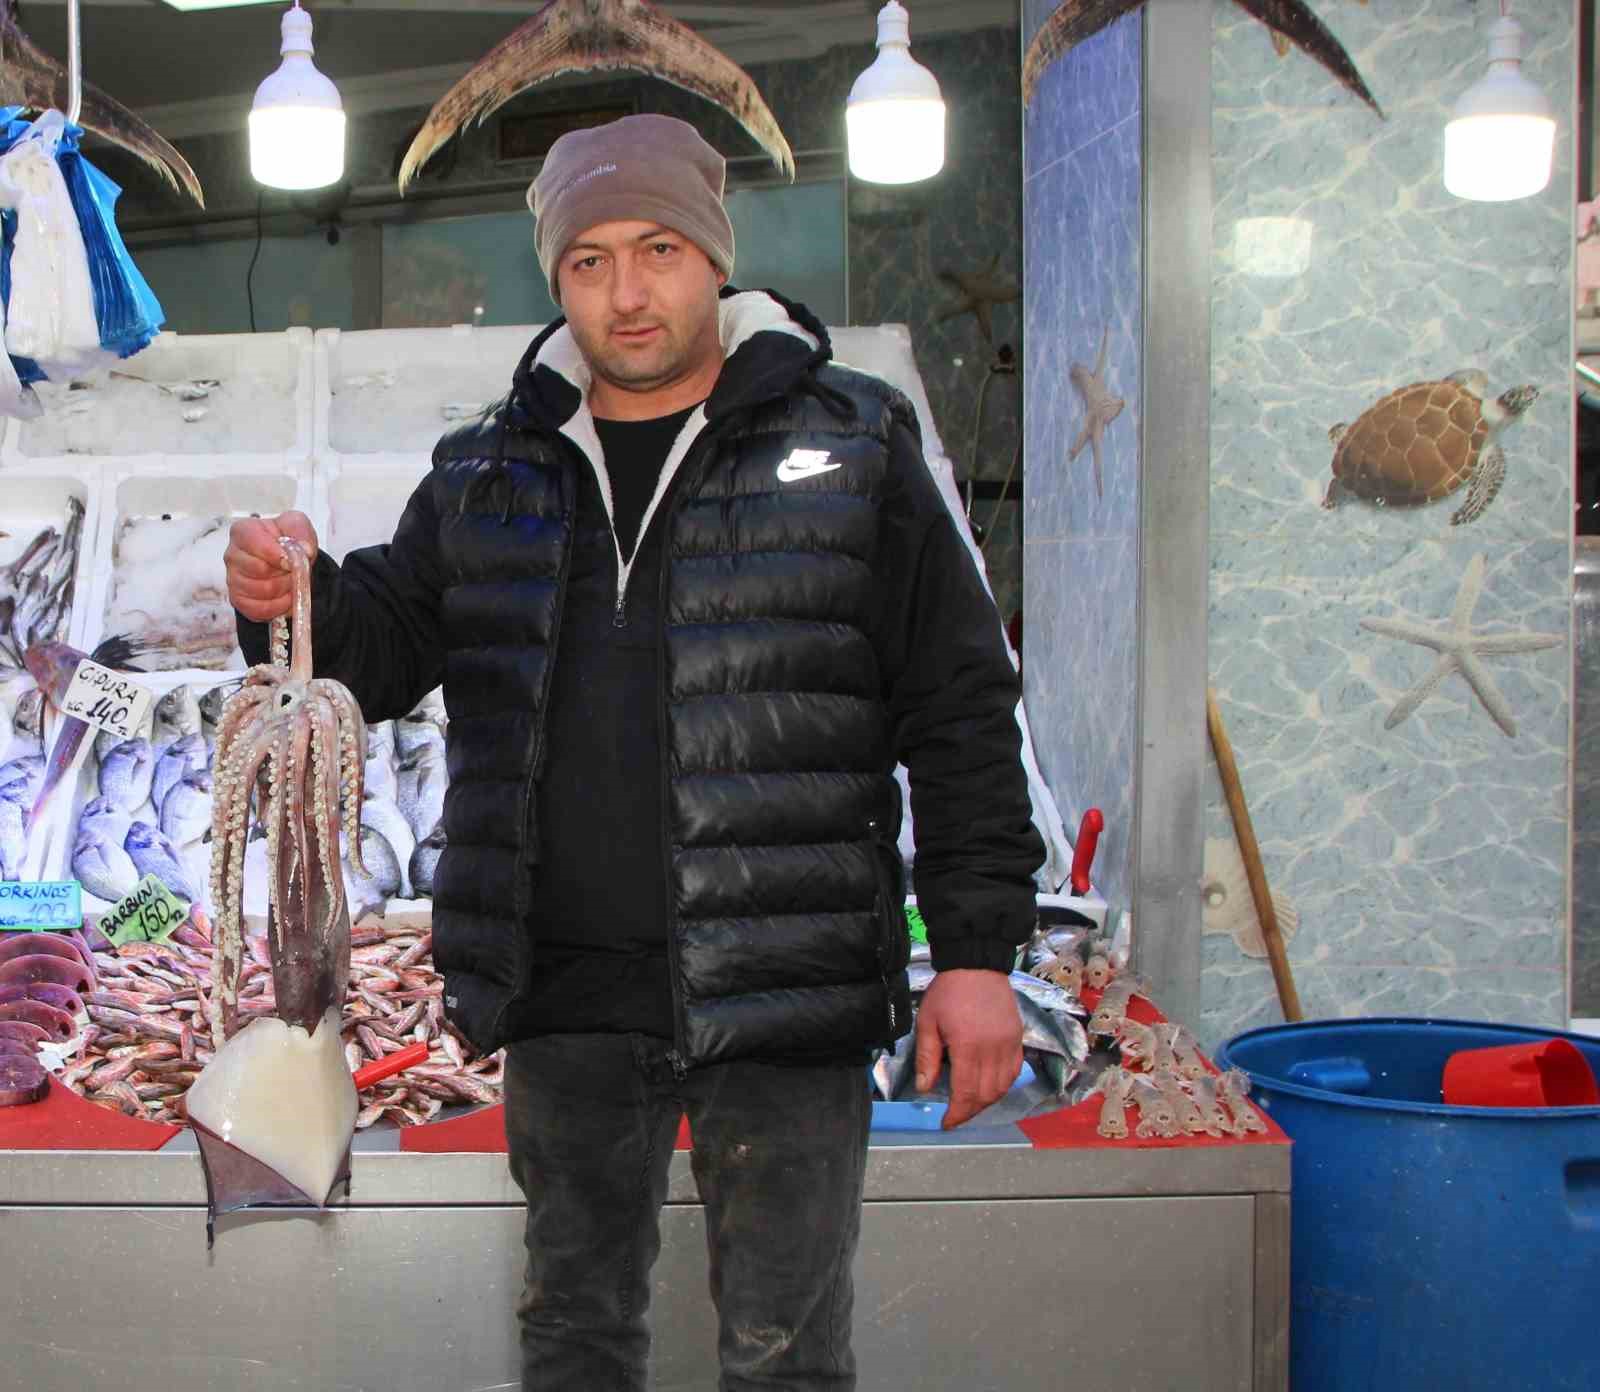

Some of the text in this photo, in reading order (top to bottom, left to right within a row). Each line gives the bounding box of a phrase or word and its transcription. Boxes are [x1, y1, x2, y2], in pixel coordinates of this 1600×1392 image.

[86, 696, 129, 725] 140
[100, 880, 153, 937] BARBUN
[138, 897, 170, 941] 150
